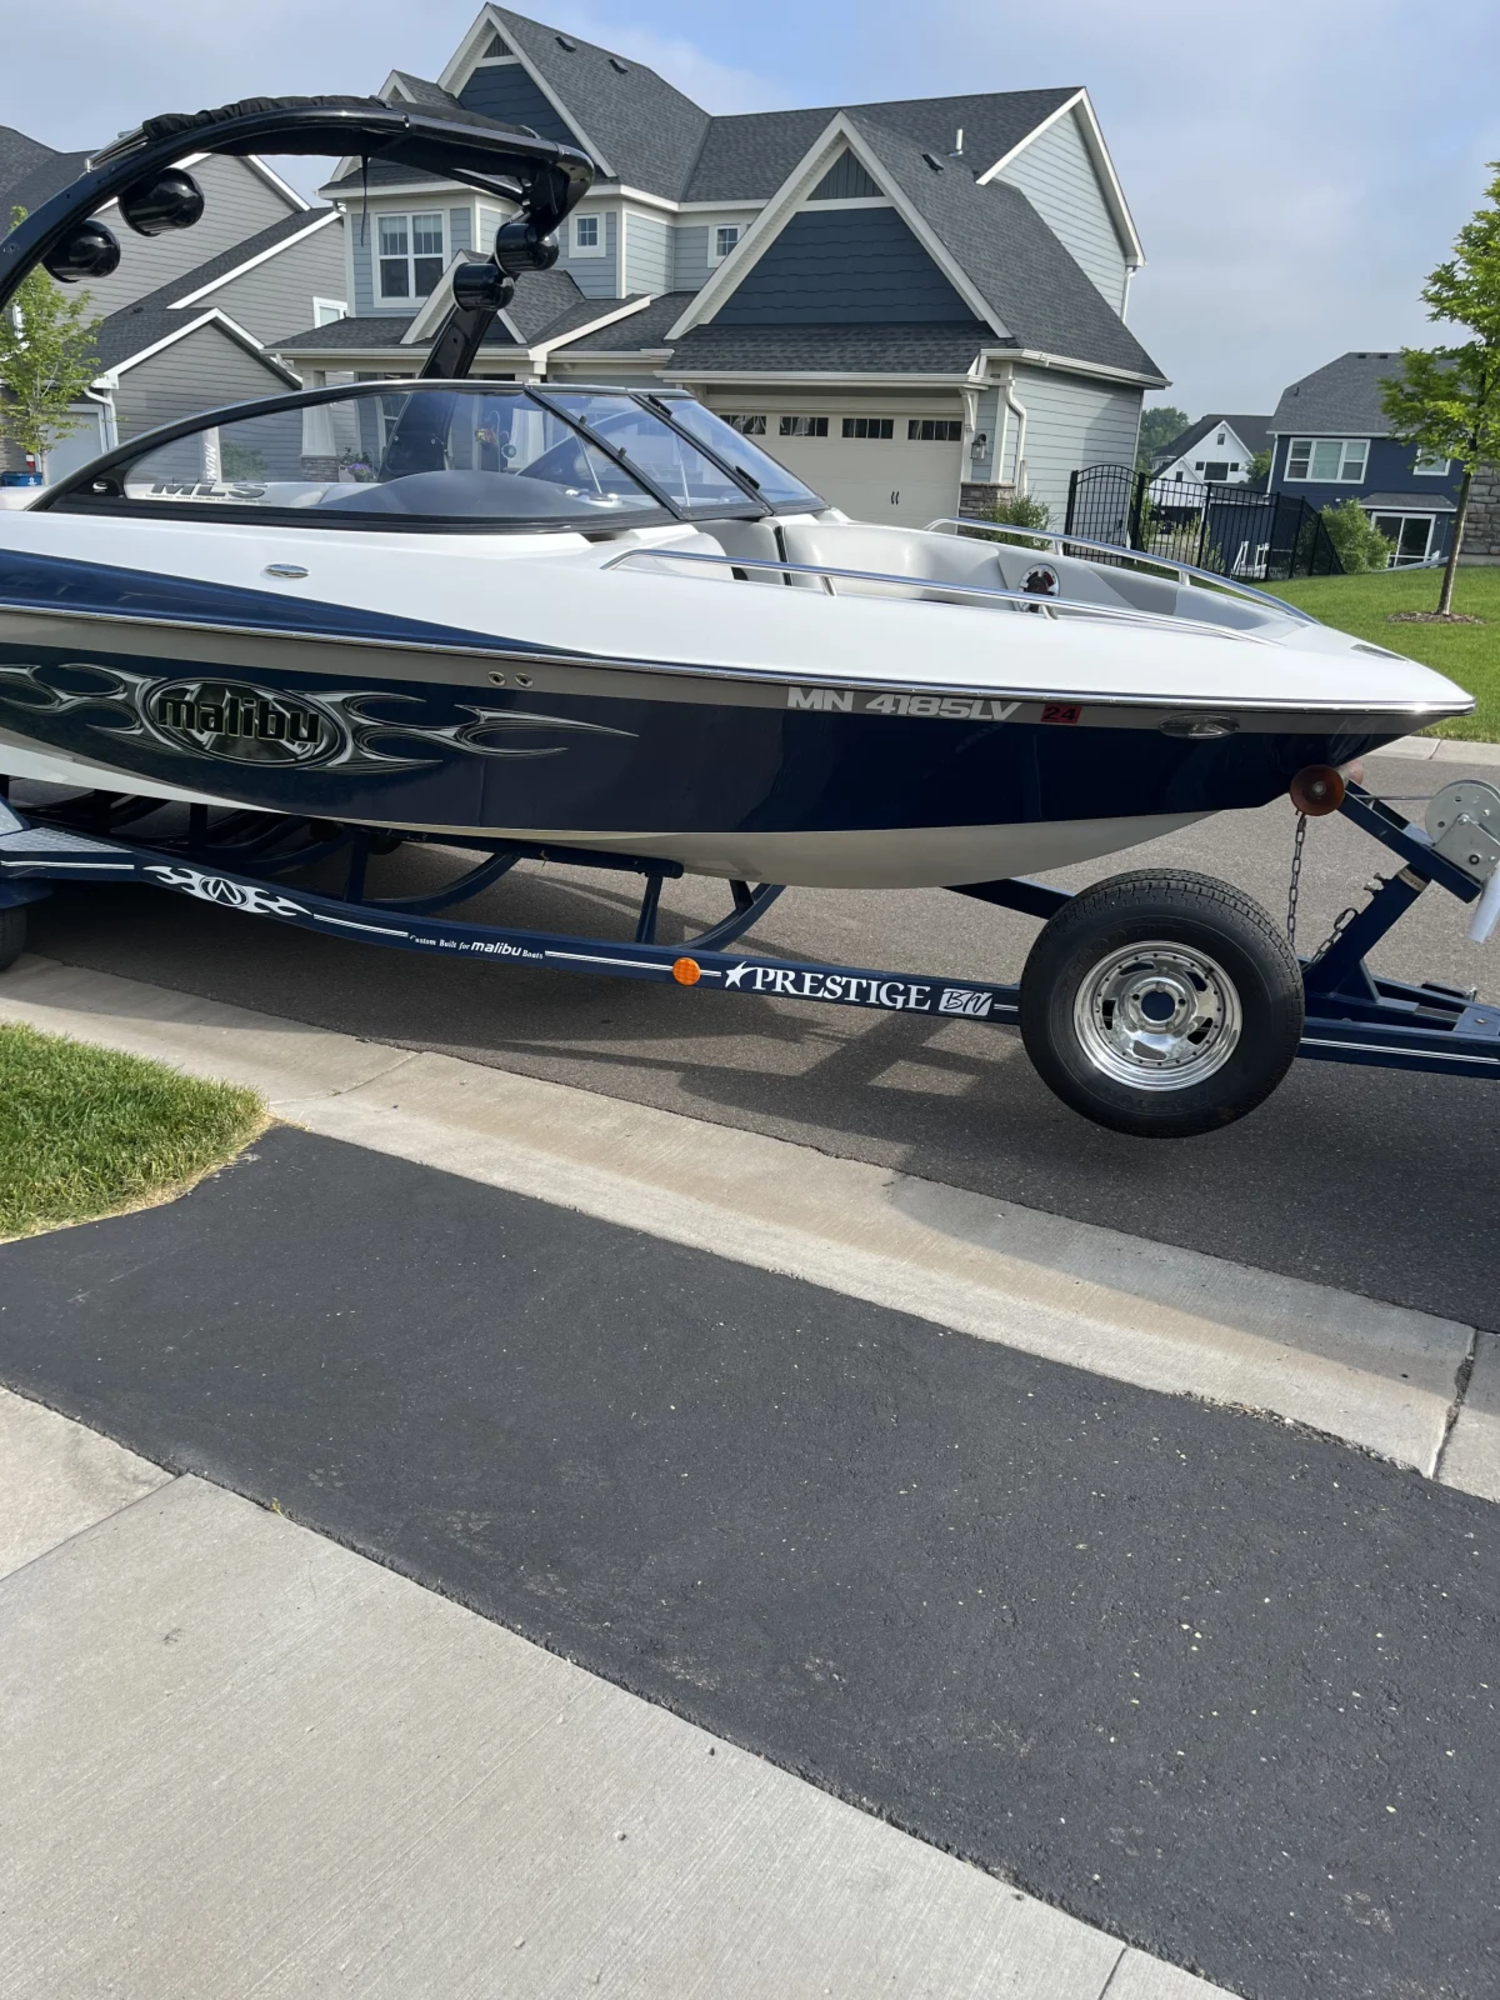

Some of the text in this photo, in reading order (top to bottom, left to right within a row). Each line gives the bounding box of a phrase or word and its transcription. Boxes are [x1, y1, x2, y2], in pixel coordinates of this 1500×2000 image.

[150, 478, 268, 499] MLS
[787, 687, 1022, 720] MN 4185LV
[1042, 706, 1076, 720] 24
[156, 696, 320, 744] malibu
[440, 938, 457, 948] Built
[458, 941, 470, 951] for
[471, 941, 522, 956] malibu
[522, 949, 544, 960] Boats
[752, 966, 930, 1011] PRESTIGE
